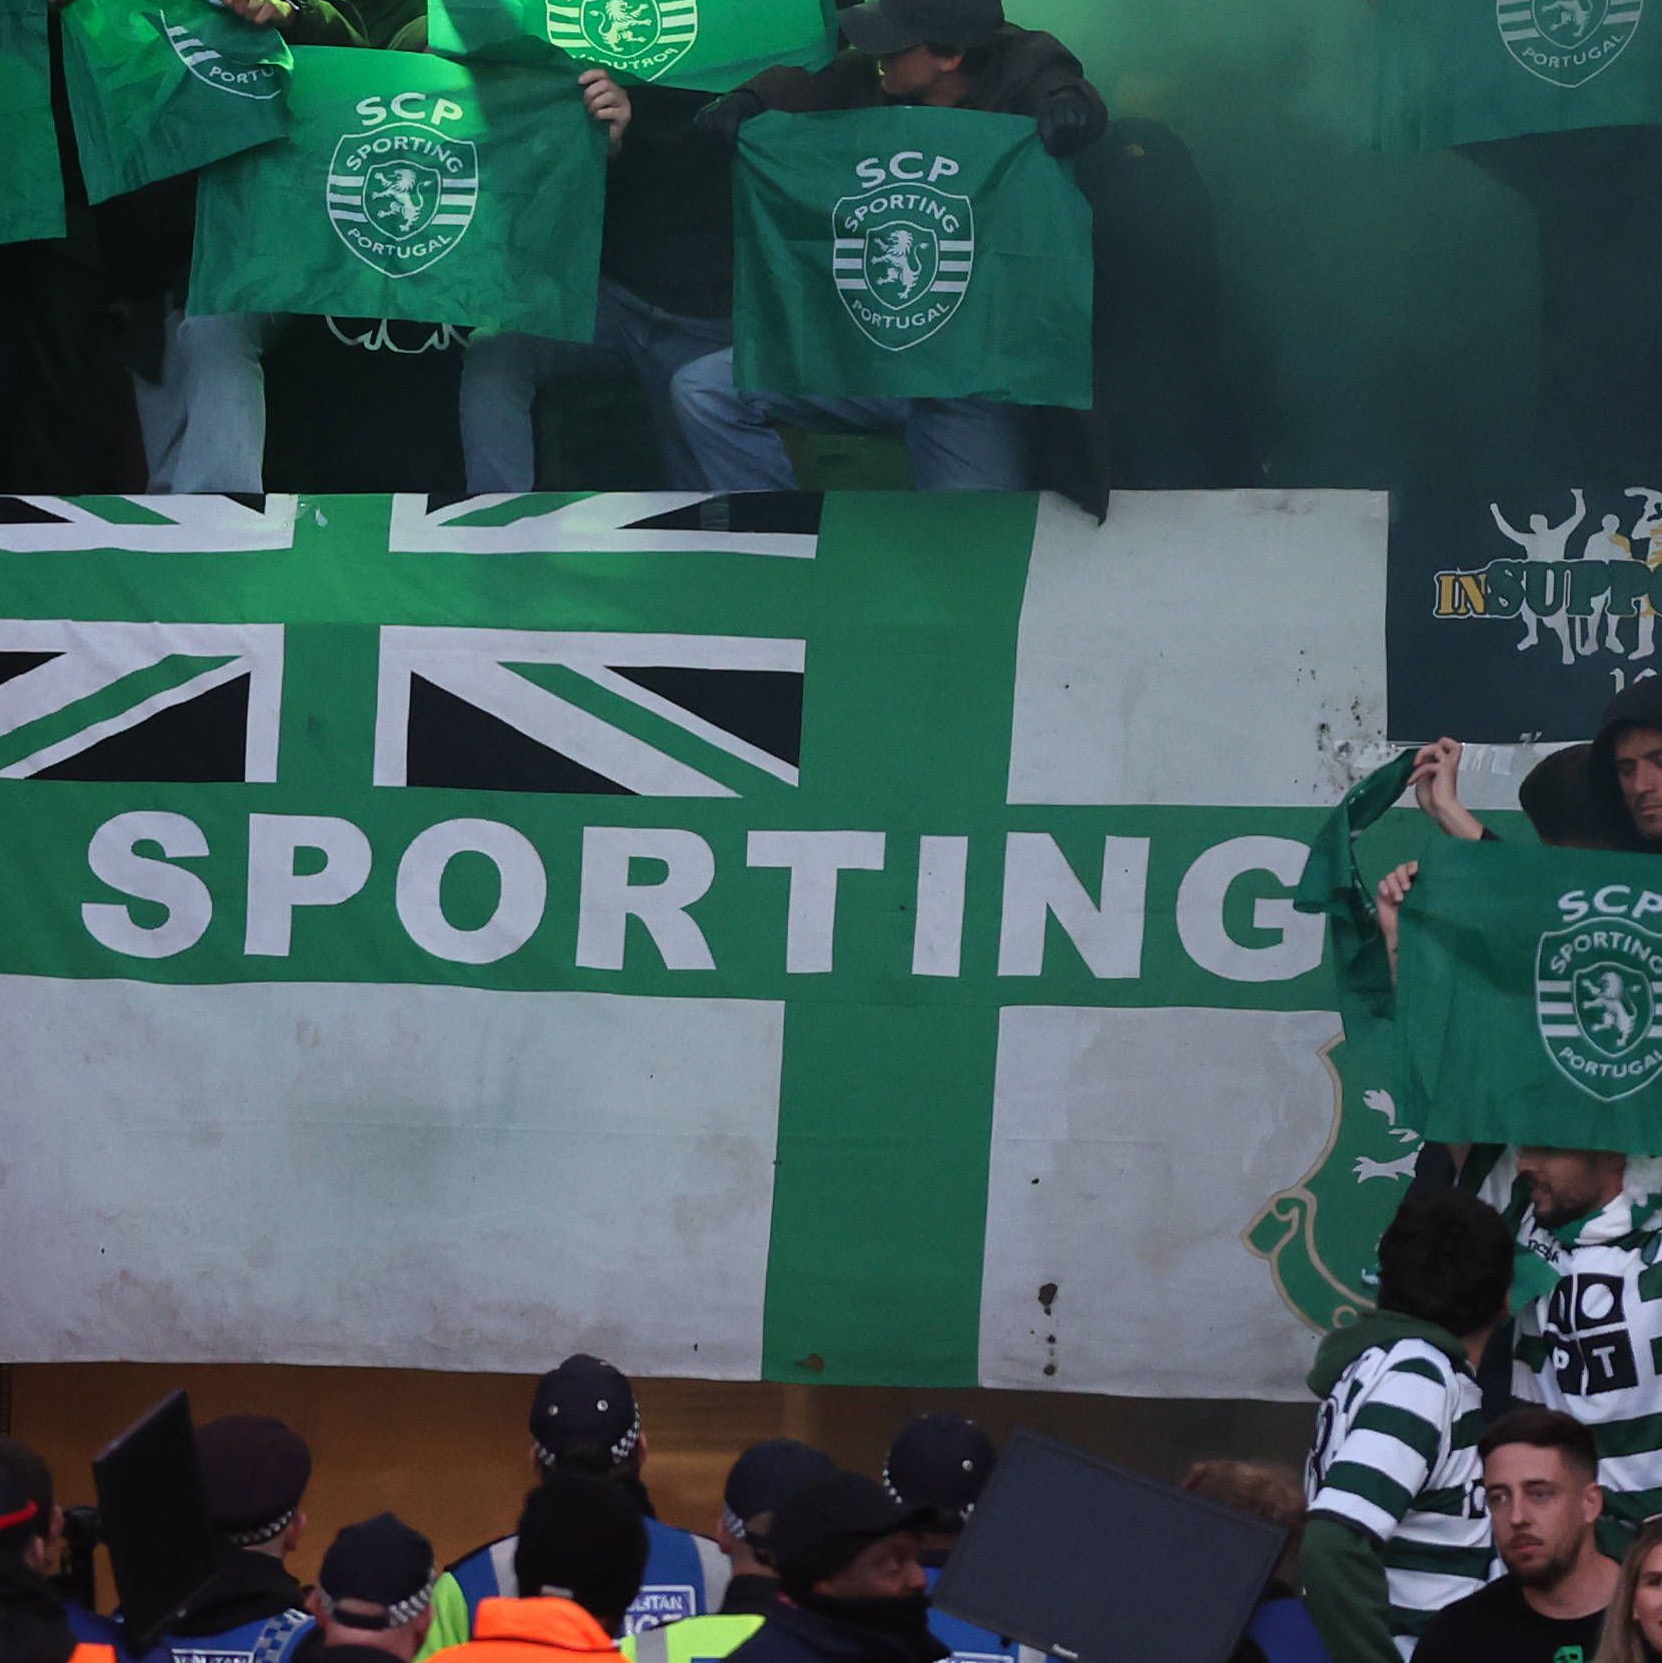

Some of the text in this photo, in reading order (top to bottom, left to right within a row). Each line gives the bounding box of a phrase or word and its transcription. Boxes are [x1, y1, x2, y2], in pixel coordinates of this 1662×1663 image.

[1520, 32, 1626, 71] PORTUGAL
[208, 63, 278, 88] PORTU
[356, 91, 464, 129] SCP
[345, 135, 464, 176] SPORTING
[856, 152, 960, 189] SCP
[843, 193, 960, 235] SPORTING
[346, 227, 453, 259] PORTUGAL
[851, 297, 952, 330] PORTUGAL
[81, 809, 1327, 982] SPORTING
